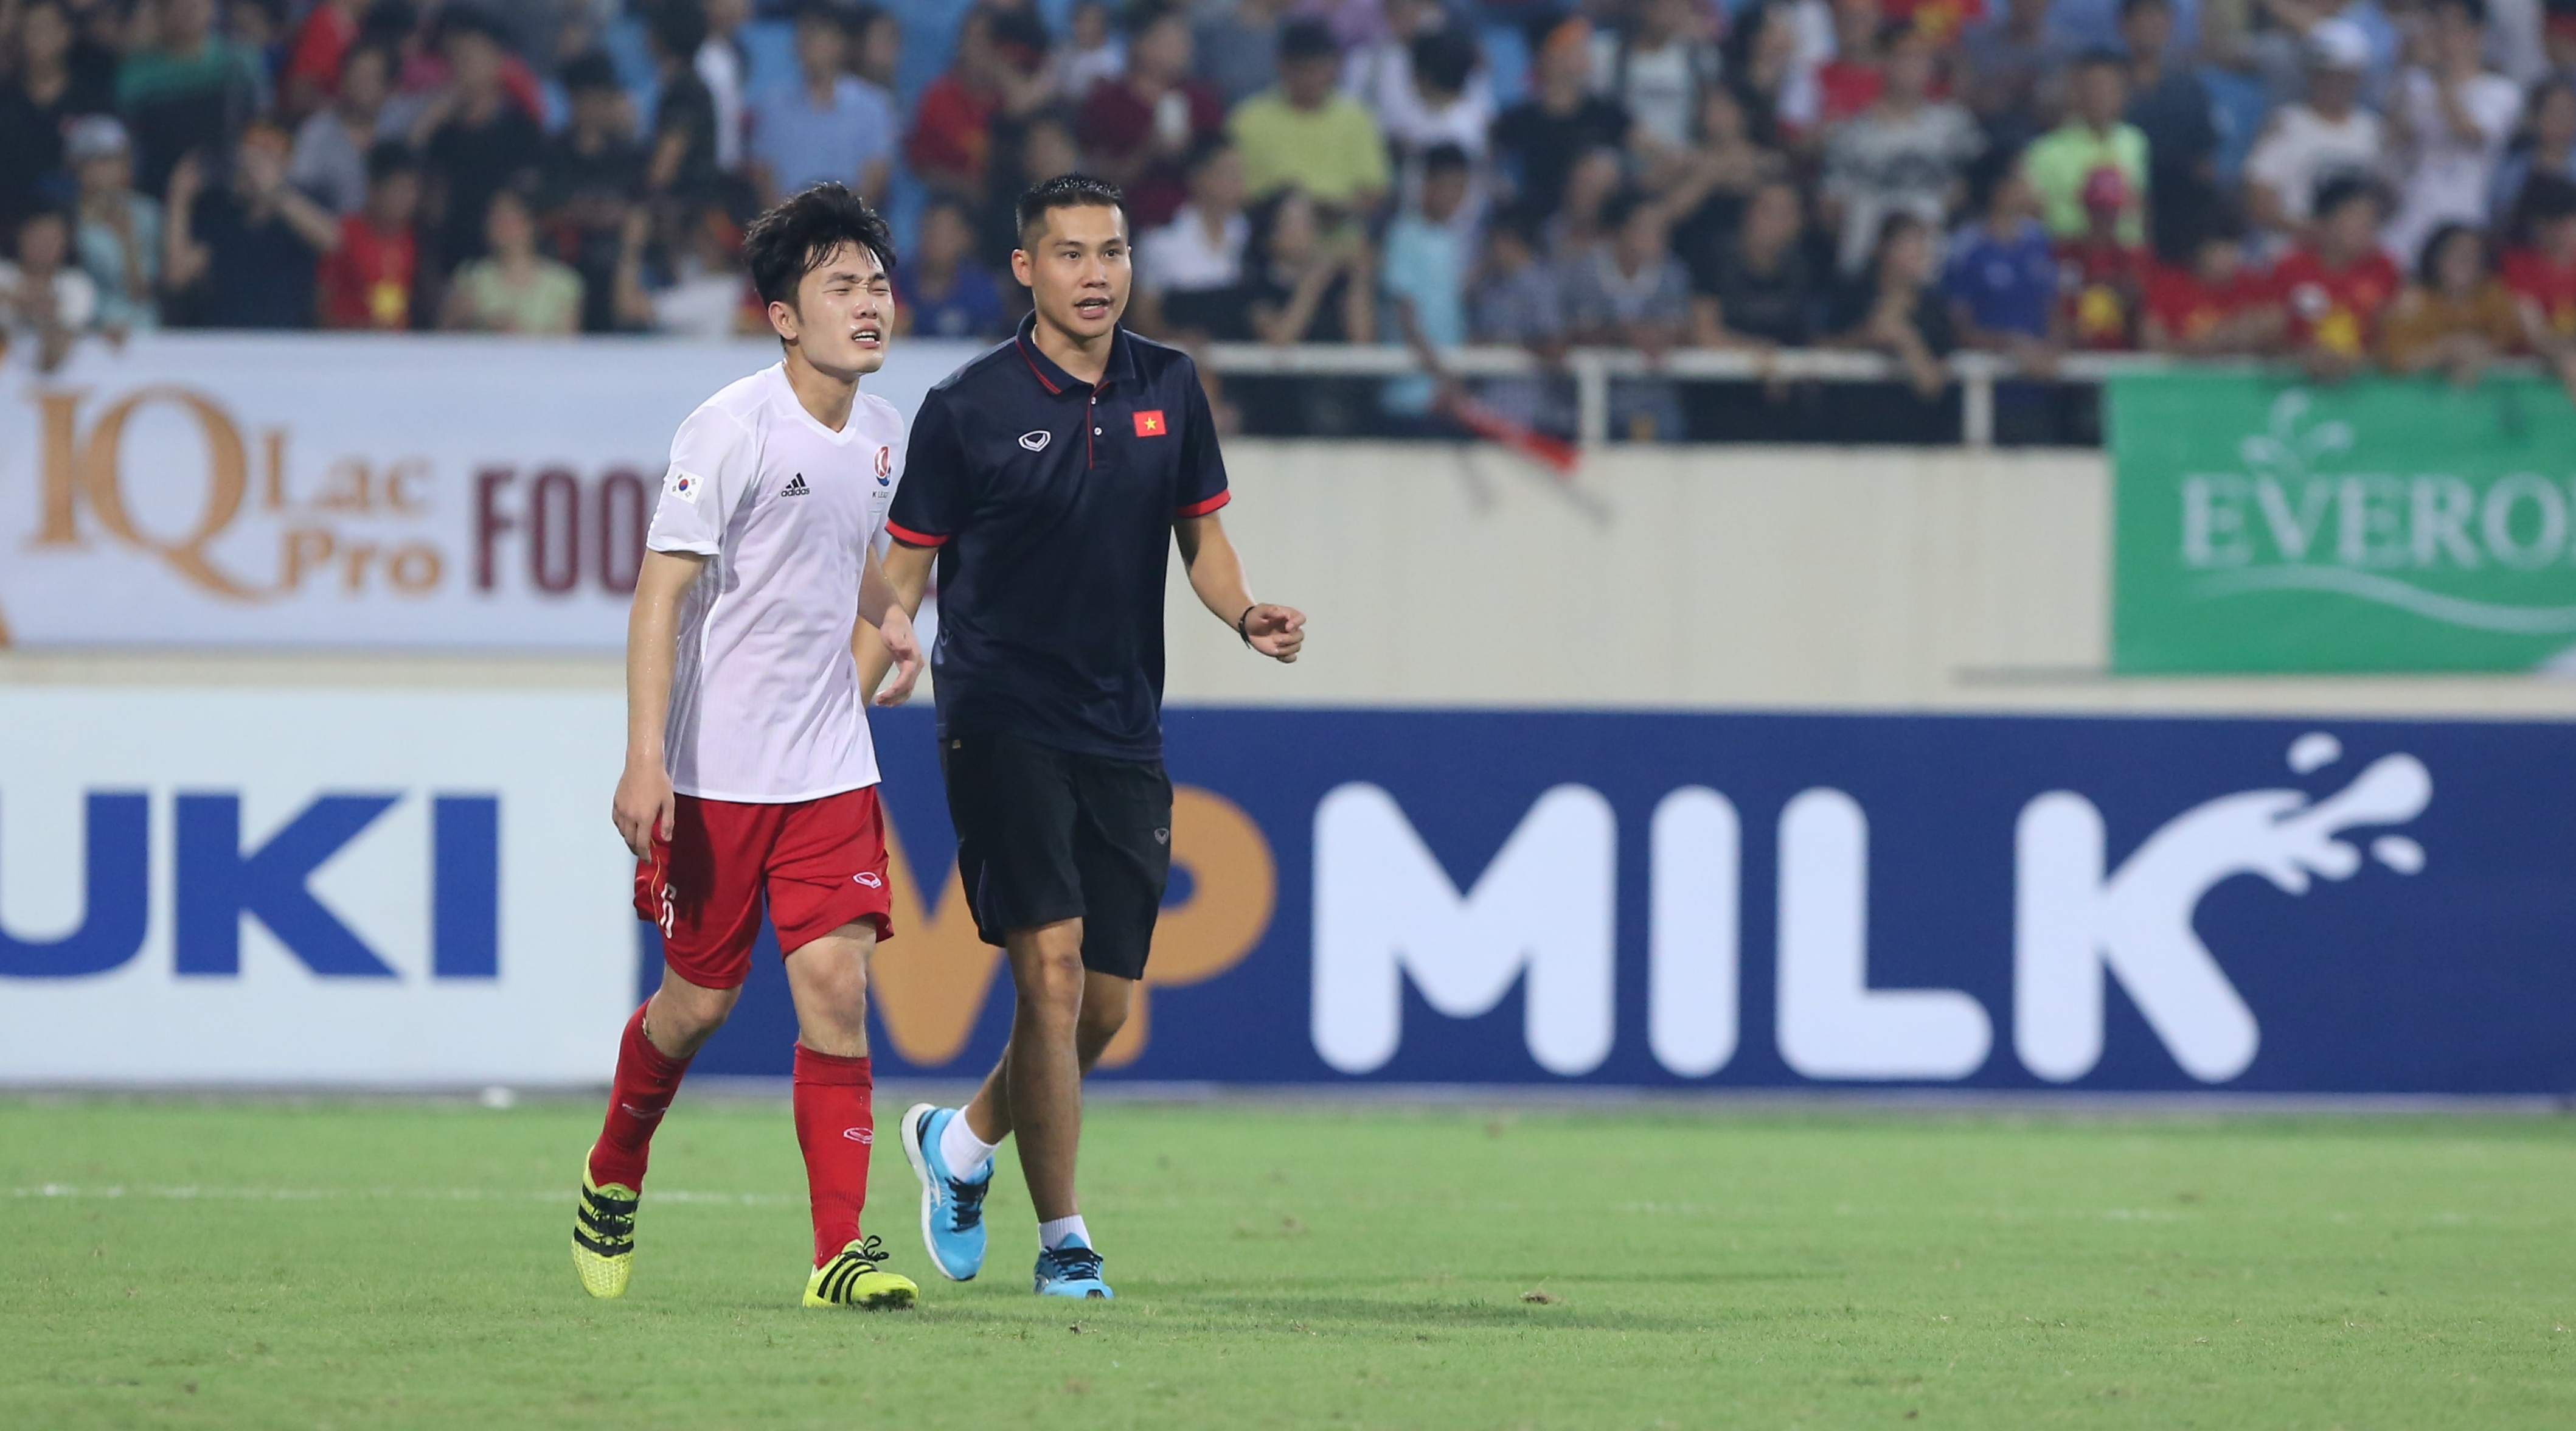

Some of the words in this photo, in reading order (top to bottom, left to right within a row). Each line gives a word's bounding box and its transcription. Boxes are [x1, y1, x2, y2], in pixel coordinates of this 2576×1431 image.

[26, 383, 293, 605] IQ
[473, 466, 664, 597] FOO
[781, 487, 810, 497] adidas
[2179, 471, 2576, 571] EVERO
[281, 526, 444, 596] Pro
[0, 789, 500, 983] UKI
